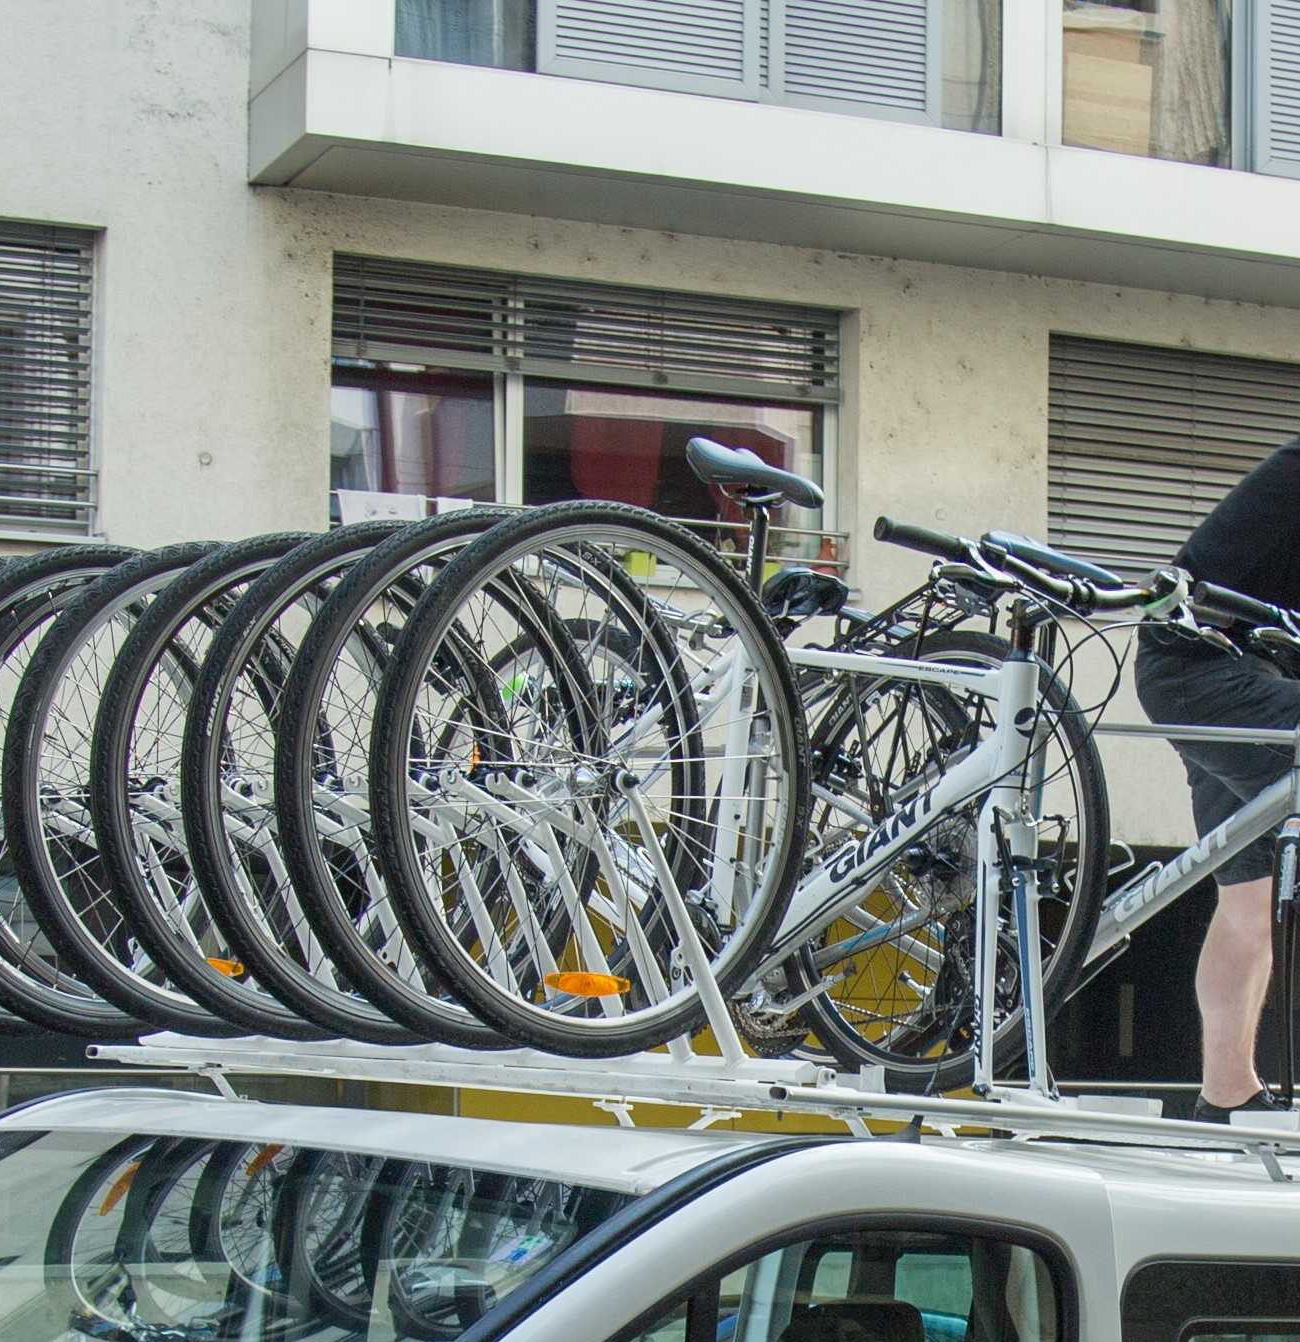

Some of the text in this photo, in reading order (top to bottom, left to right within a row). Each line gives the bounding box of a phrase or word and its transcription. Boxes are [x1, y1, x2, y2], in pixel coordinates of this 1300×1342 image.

[206, 676, 226, 737] GIANT
[829, 782, 938, 883] GIANT
[1114, 814, 1237, 923] GIANT
